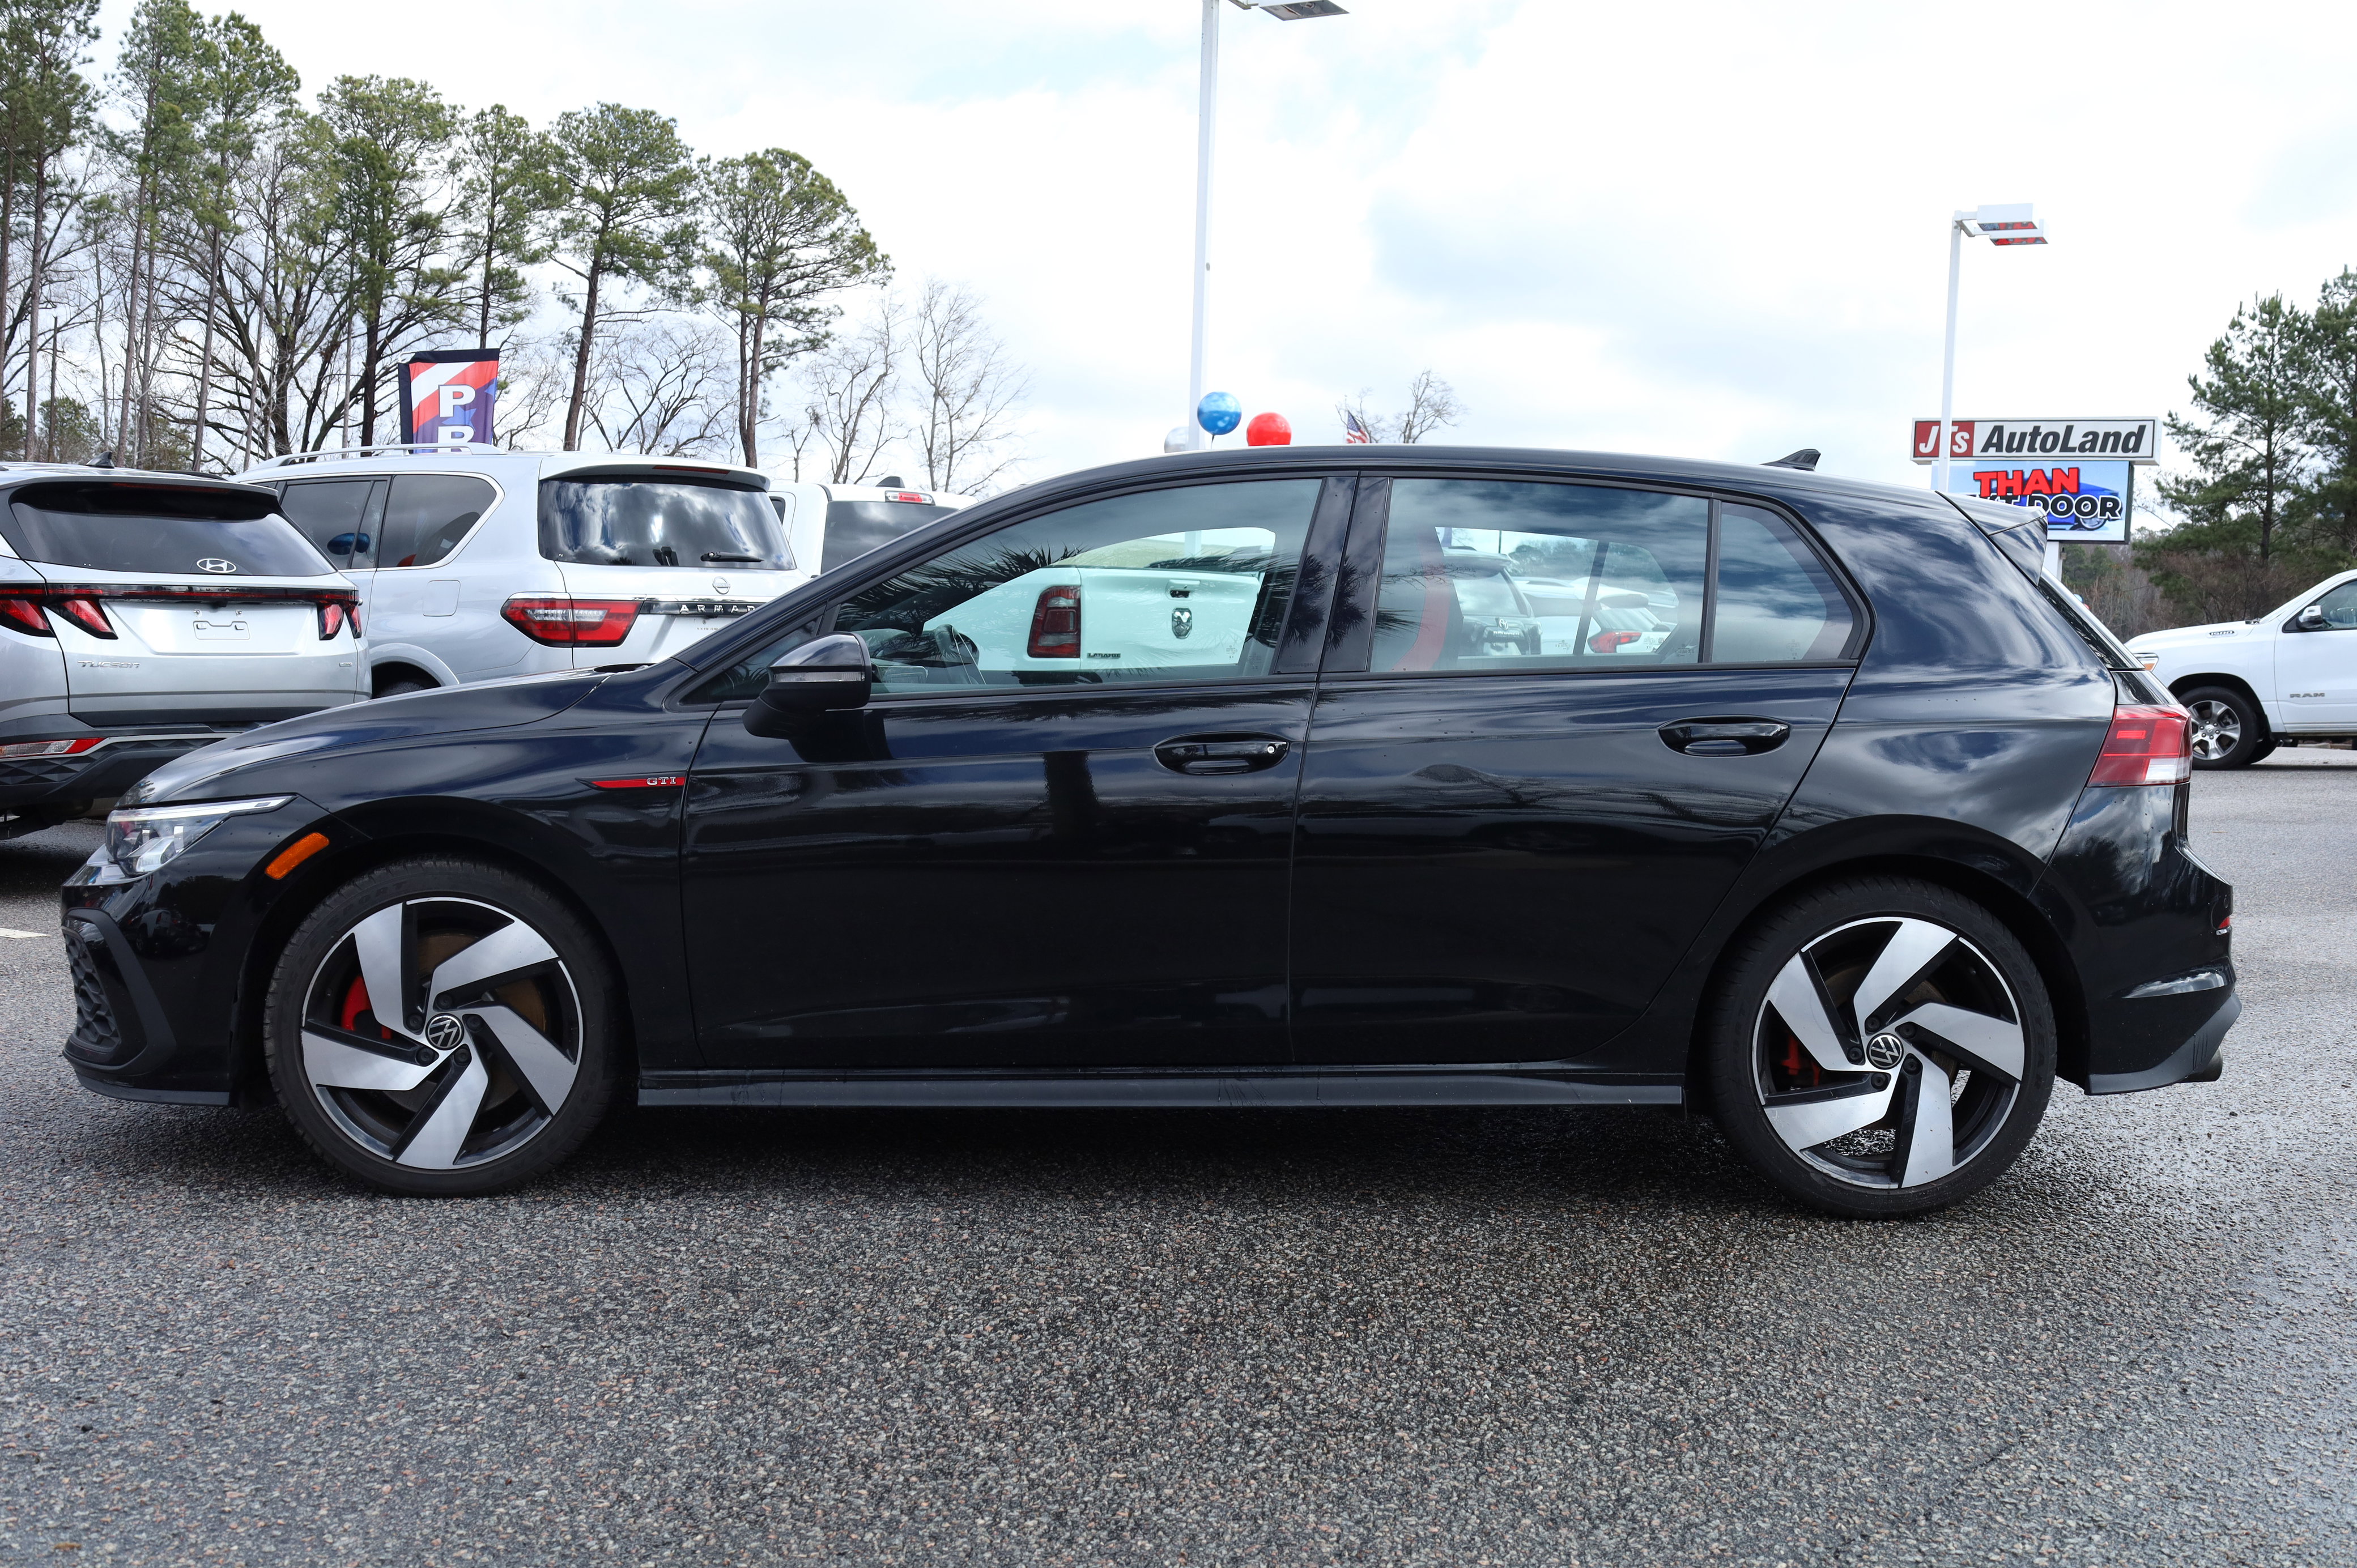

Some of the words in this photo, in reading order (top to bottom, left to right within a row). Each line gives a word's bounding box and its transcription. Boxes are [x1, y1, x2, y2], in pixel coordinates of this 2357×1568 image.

[1980, 424, 2147, 453] AutoLand
[1973, 467, 2079, 497] THAN
[646, 777, 677, 785] GTI
